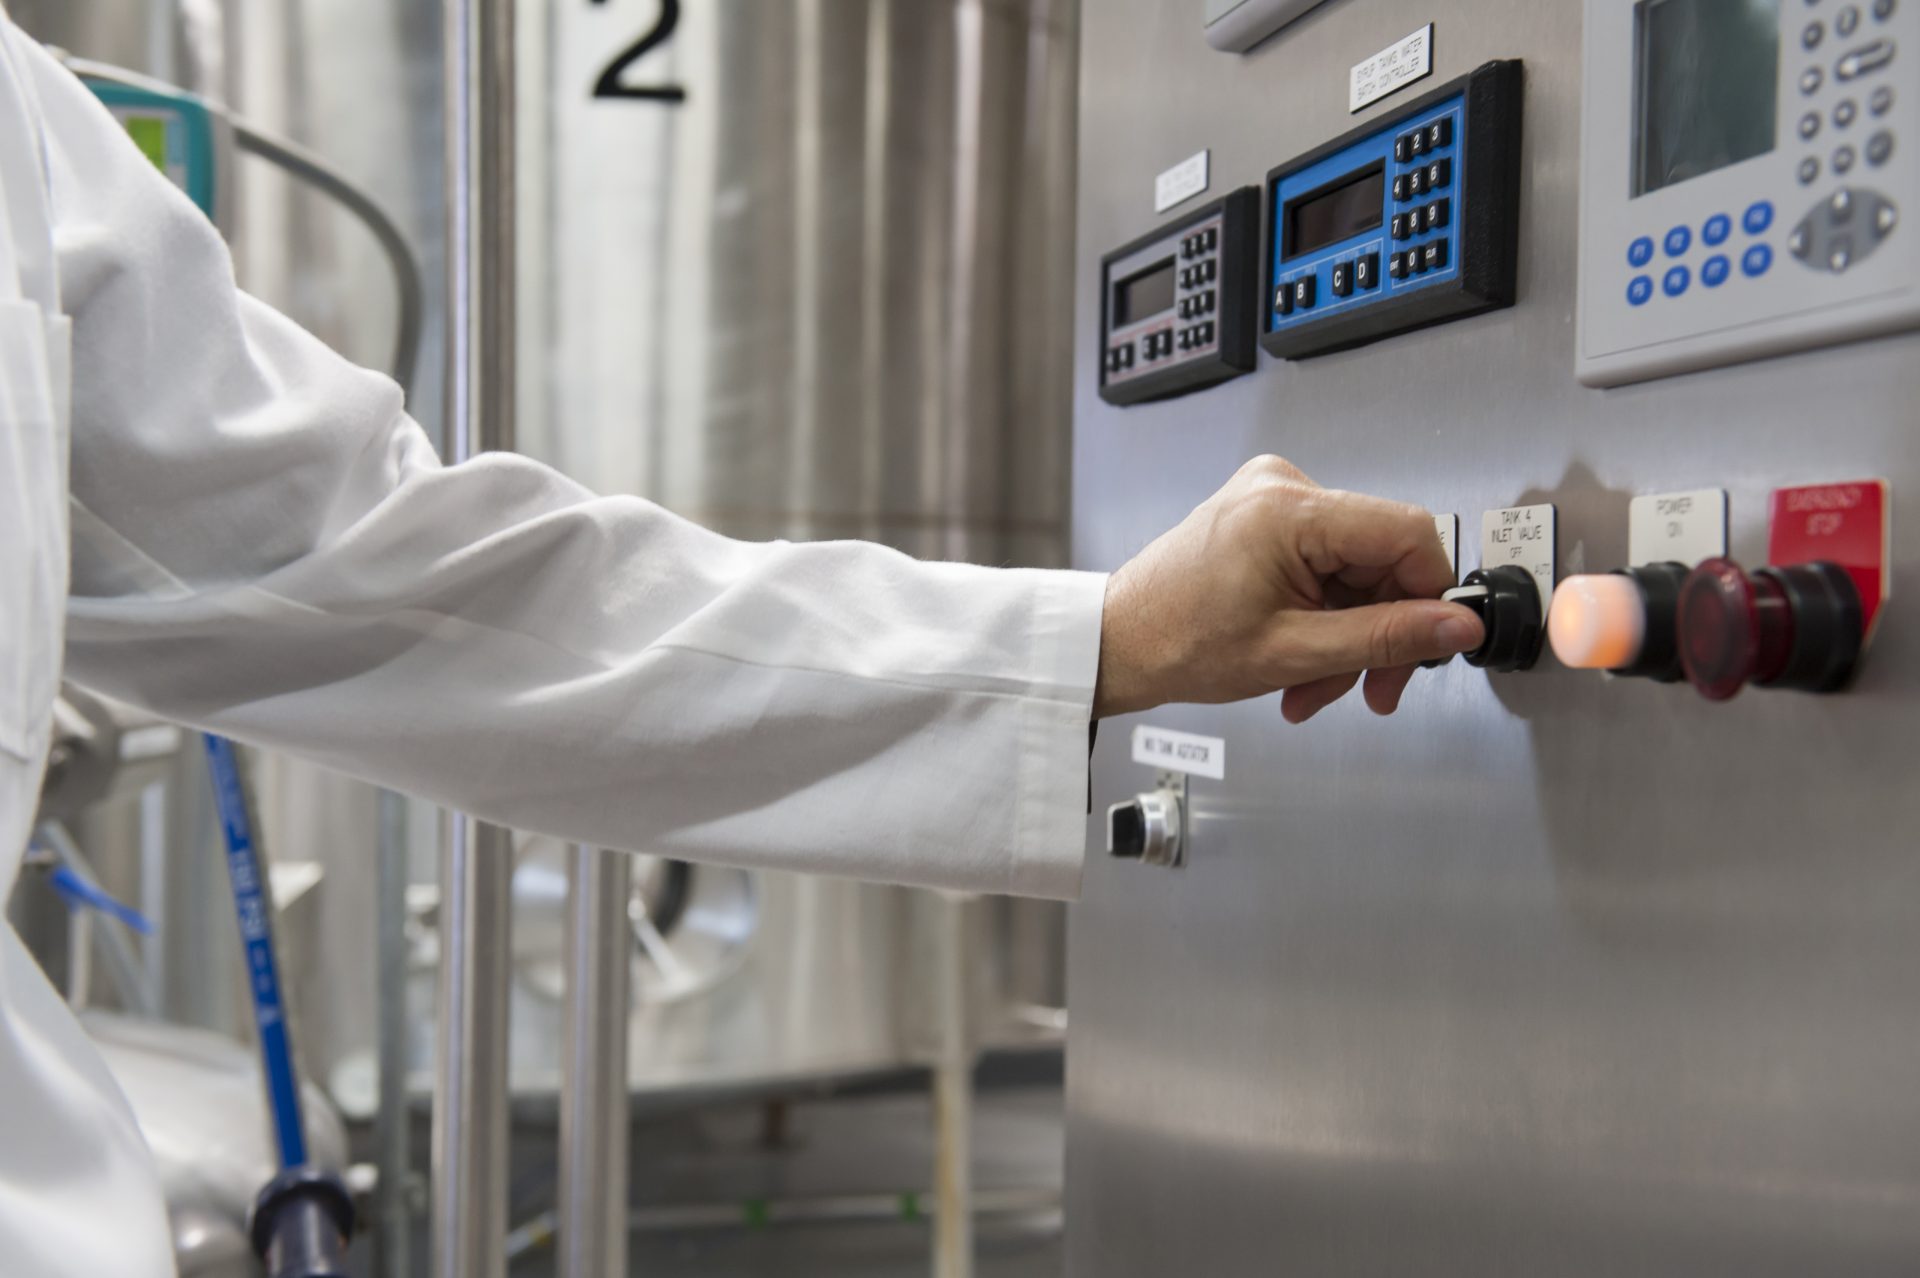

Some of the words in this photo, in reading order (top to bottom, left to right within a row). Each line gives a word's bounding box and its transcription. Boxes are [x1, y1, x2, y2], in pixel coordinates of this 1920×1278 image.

[588, 0, 687, 101] 2
[1401, 36, 1423, 57] WATER
[1379, 56, 1420, 89] CONTROLLER
[1396, 142, 1402, 157] 1
[1413, 134, 1420, 150] 2
[1432, 125, 1439, 141] 3
[1394, 180, 1400, 194] 4
[1411, 173, 1419, 189] 5
[1430, 165, 1437, 181] 6
[1393, 219, 1400, 235] 7
[1410, 212, 1417, 228] 8
[1429, 205, 1436, 221] 9
[1276, 291, 1282, 306] A
[1297, 283, 1304, 300] B
[1334, 270, 1342, 288] C
[1358, 262, 1366, 280] D
[1501, 510, 1521, 526] TANK
[1525, 508, 1532, 520] 4
[1656, 497, 1692, 516] POWER
[1491, 527, 1513, 543] INLET
[1519, 525, 1543, 541] VALVE
[1667, 521, 1682, 538] ON
[1805, 512, 1842, 536] STOP
[1510, 546, 1523, 559] OFF
